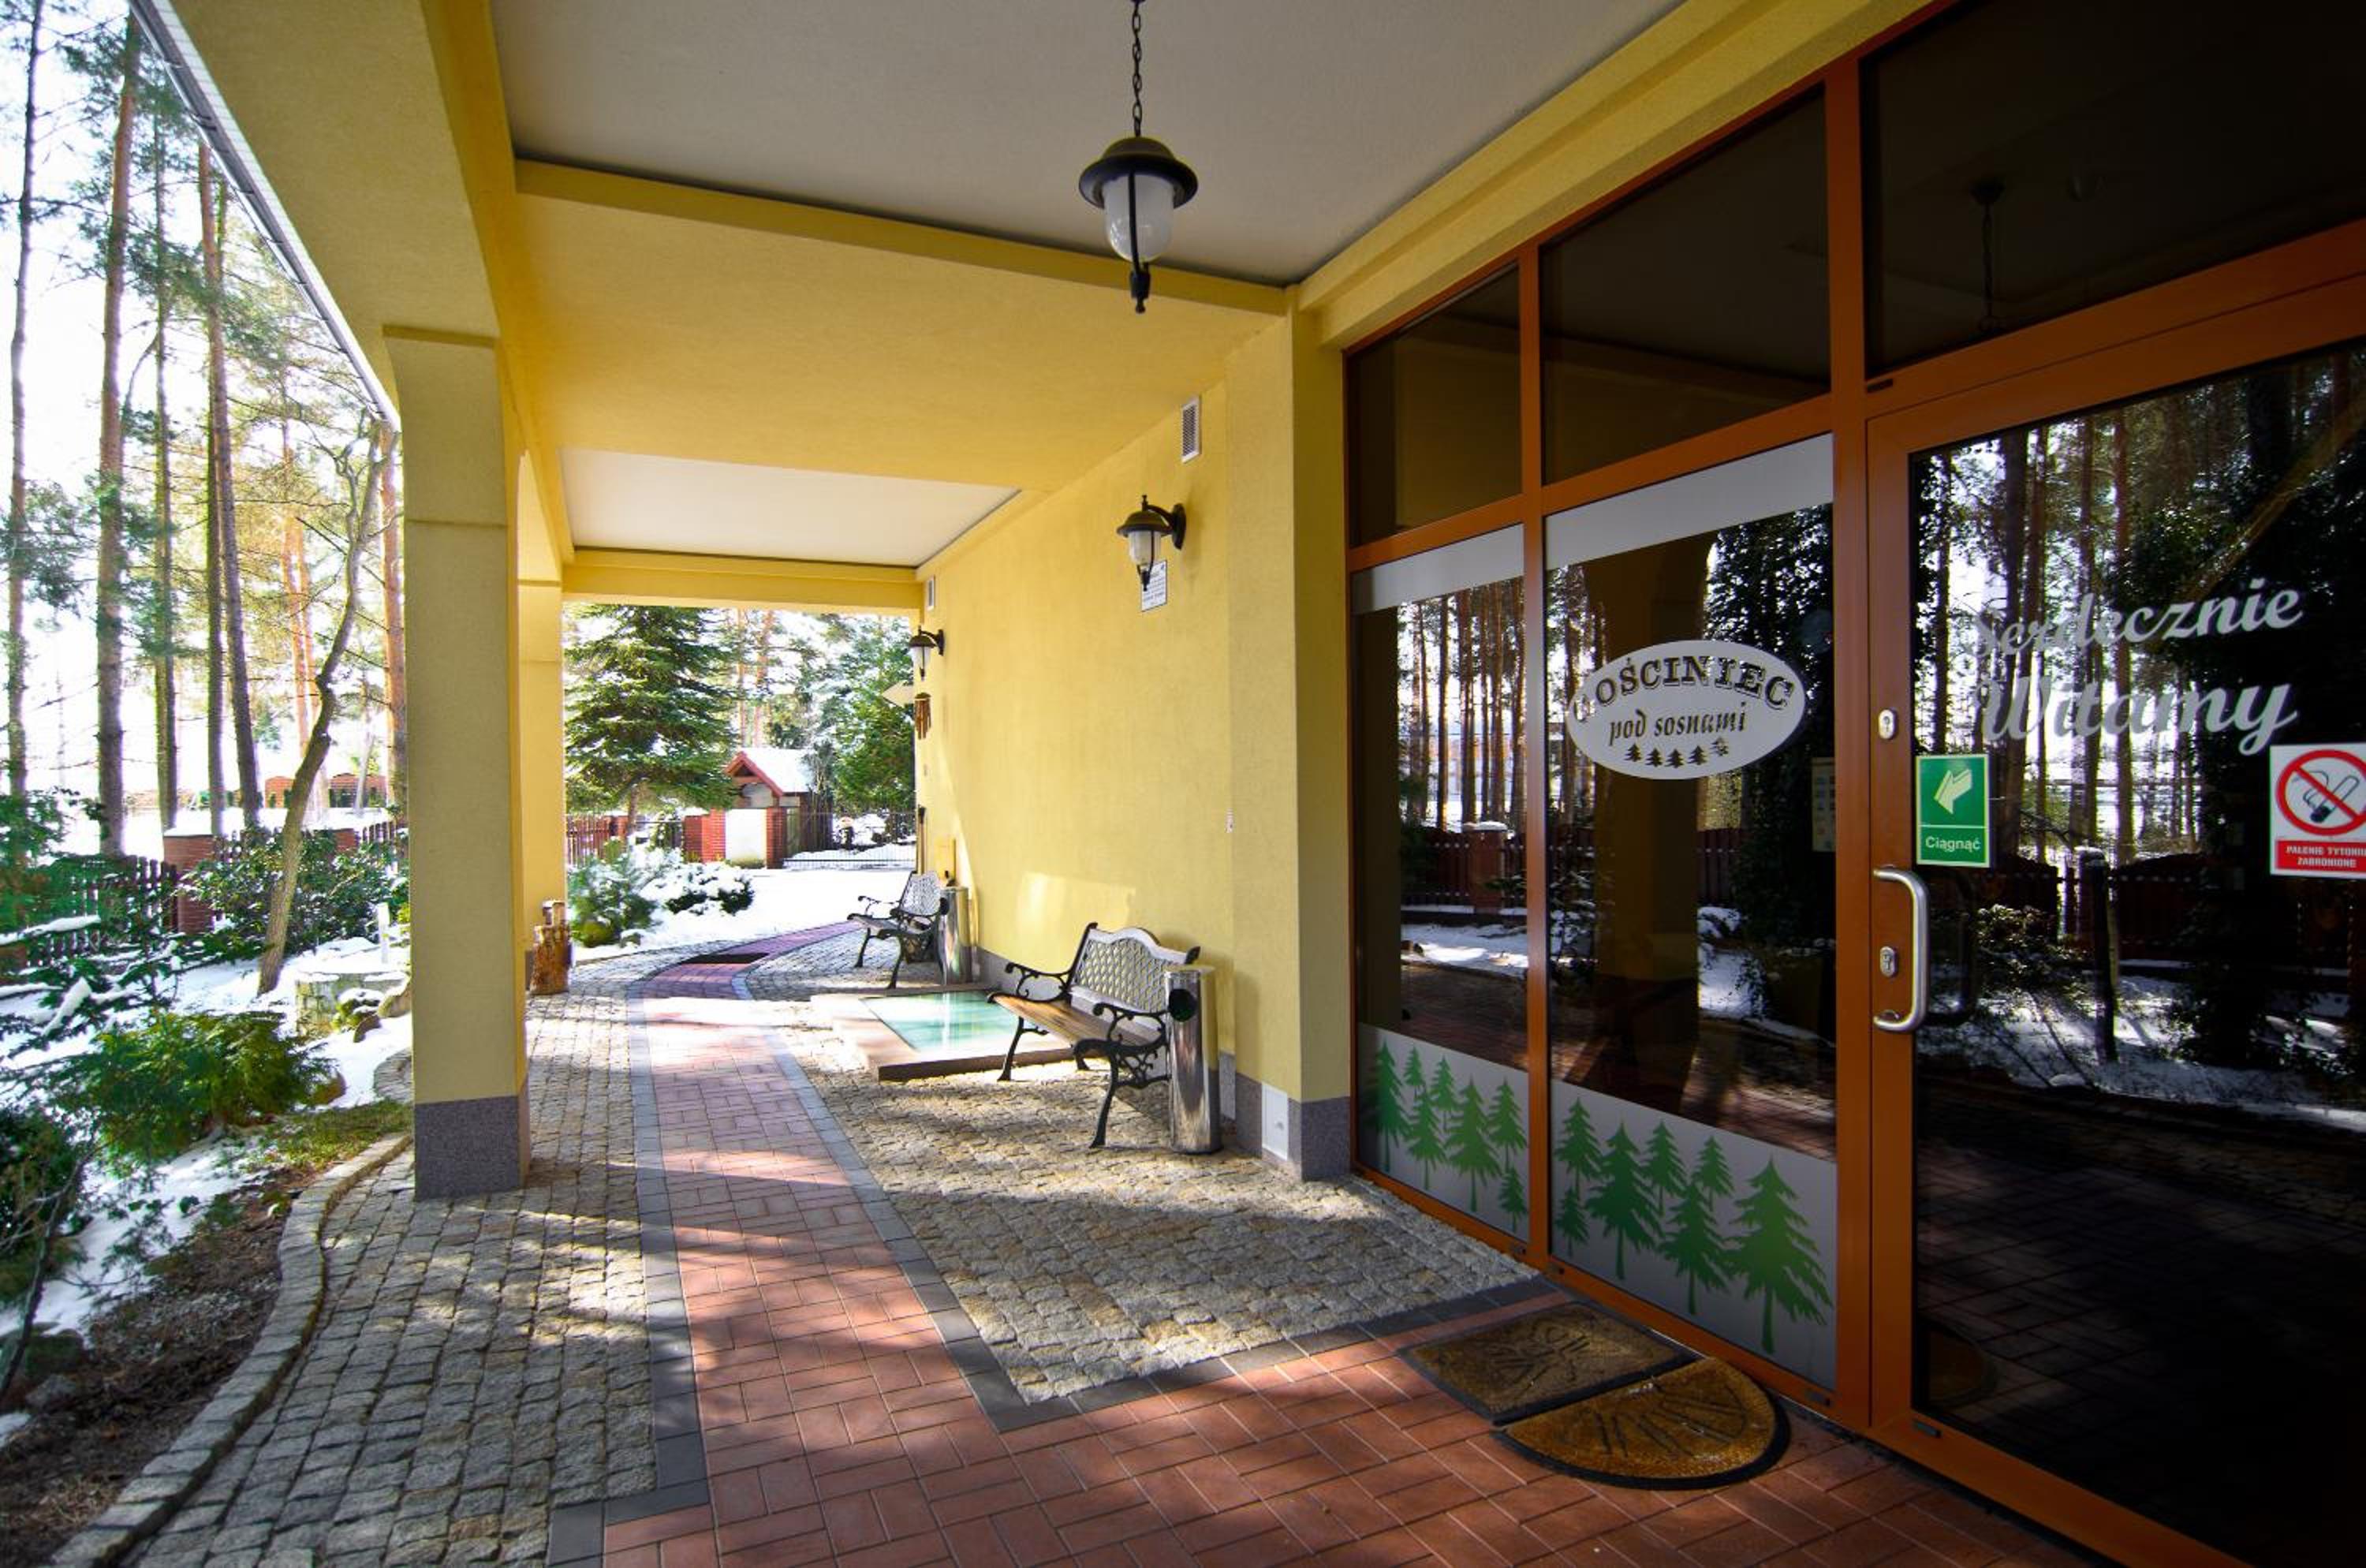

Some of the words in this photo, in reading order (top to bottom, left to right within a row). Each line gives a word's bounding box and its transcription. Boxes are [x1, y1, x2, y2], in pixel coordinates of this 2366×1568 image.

[1974, 578, 2304, 658] Serdecznie
[1608, 709, 1647, 746] pod
[1654, 701, 1747, 737] sosnami
[1974, 676, 2298, 756] Witamy
[1925, 835, 1982, 853] Ciągnąć
